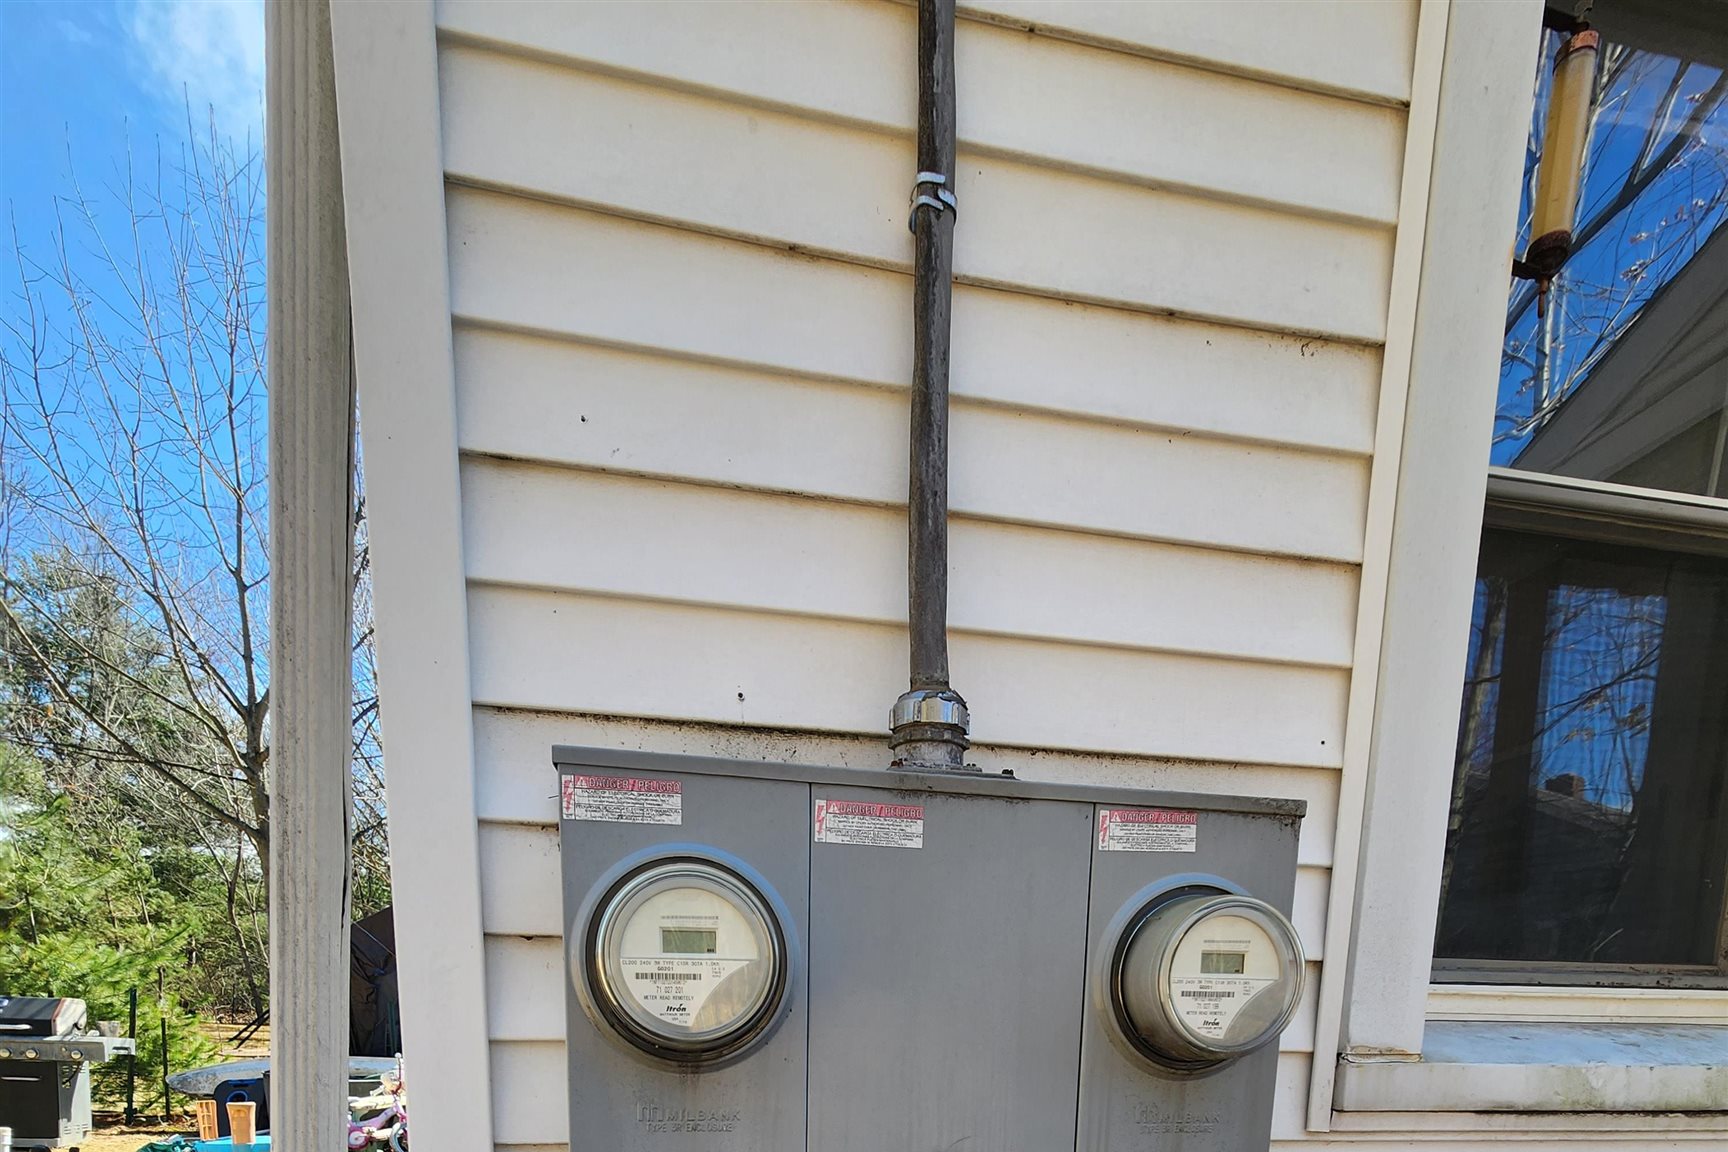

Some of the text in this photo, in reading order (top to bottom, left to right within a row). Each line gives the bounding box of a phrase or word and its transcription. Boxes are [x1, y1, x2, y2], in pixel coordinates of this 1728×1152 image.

[589, 777, 628, 789] DANGER
[638, 780, 681, 793] PELIGRO
[840, 803, 877, 815] DANGER
[885, 807, 922, 818] PELIGRO
[1121, 812, 1155, 823] DANGER
[1161, 813, 1196, 823] PELIGRO
[666, 1003, 687, 1012] Itron
[1202, 1018, 1220, 1026] Itron
[667, 1107, 741, 1122] MILBANK
[647, 1123, 667, 1133] TYPE
